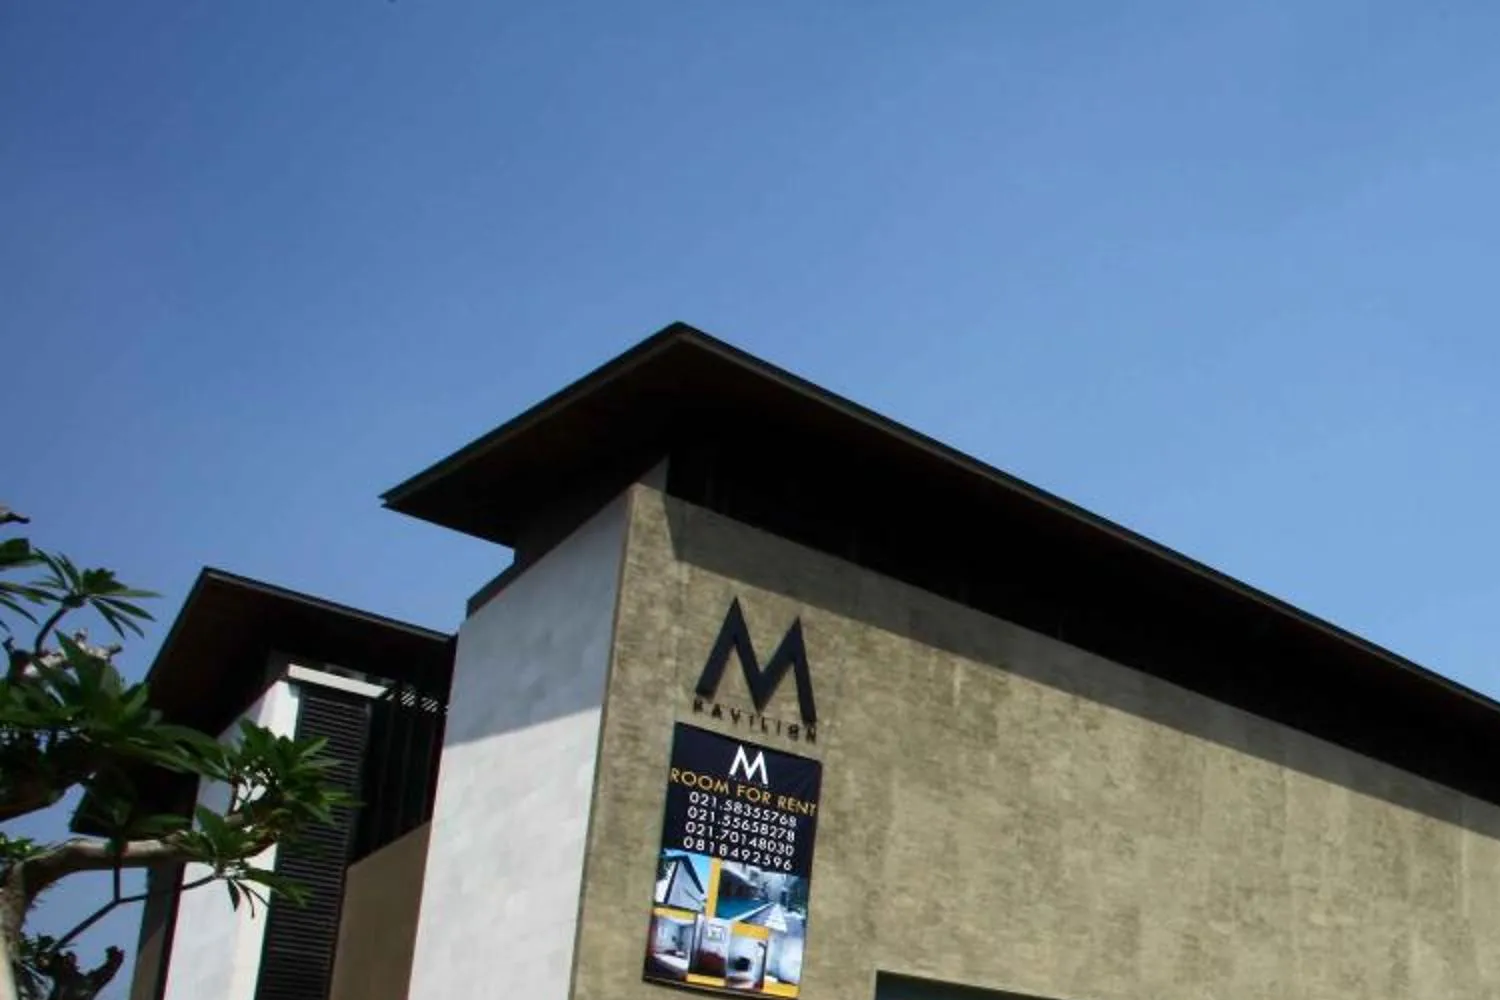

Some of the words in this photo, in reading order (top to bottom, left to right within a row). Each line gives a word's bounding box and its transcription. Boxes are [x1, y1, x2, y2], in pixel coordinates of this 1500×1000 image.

[695, 596, 817, 728] M
[729, 744, 769, 785] M
[669, 767, 729, 795] ROOM
[736, 785, 771, 805] FOR
[777, 795, 816, 817] RENT
